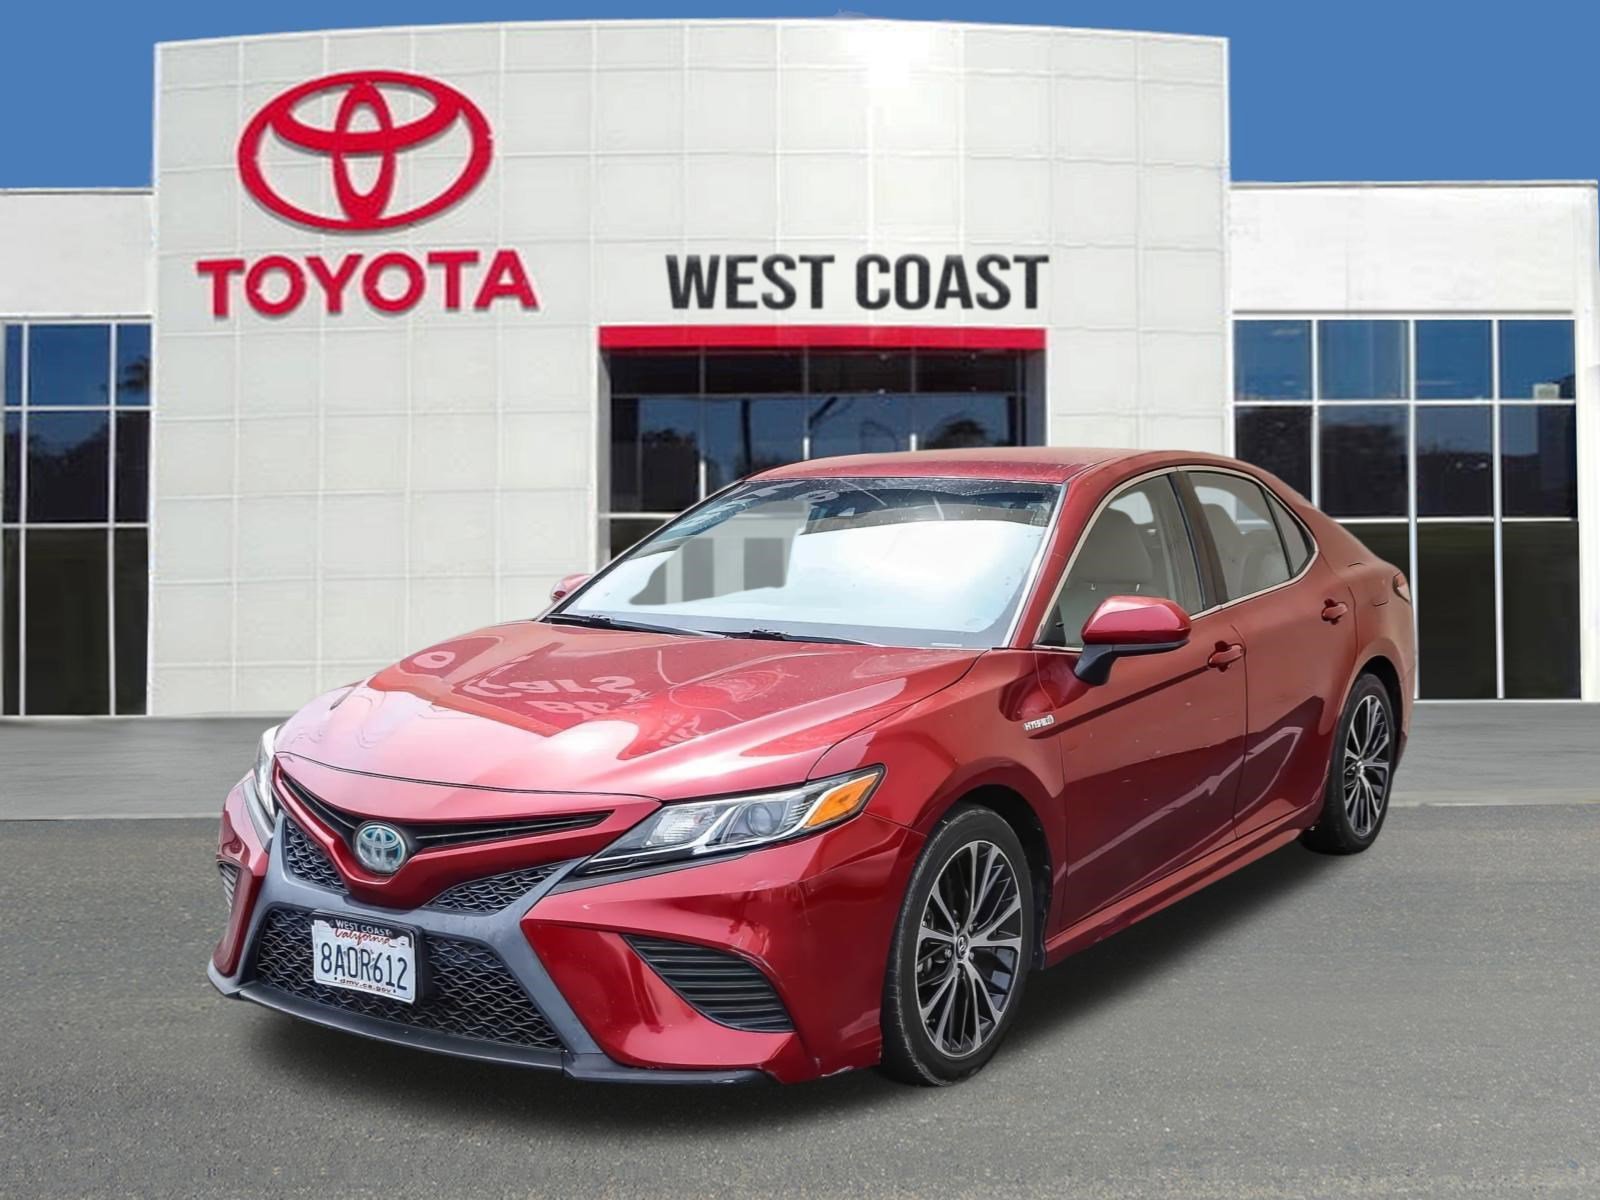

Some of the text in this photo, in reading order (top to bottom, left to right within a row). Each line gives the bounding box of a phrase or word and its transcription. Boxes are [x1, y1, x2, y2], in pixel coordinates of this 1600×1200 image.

[196, 249, 540, 318] TOYOTA
[665, 253, 1050, 310] WEST COAST
[335, 919, 390, 936] WEST COAST
